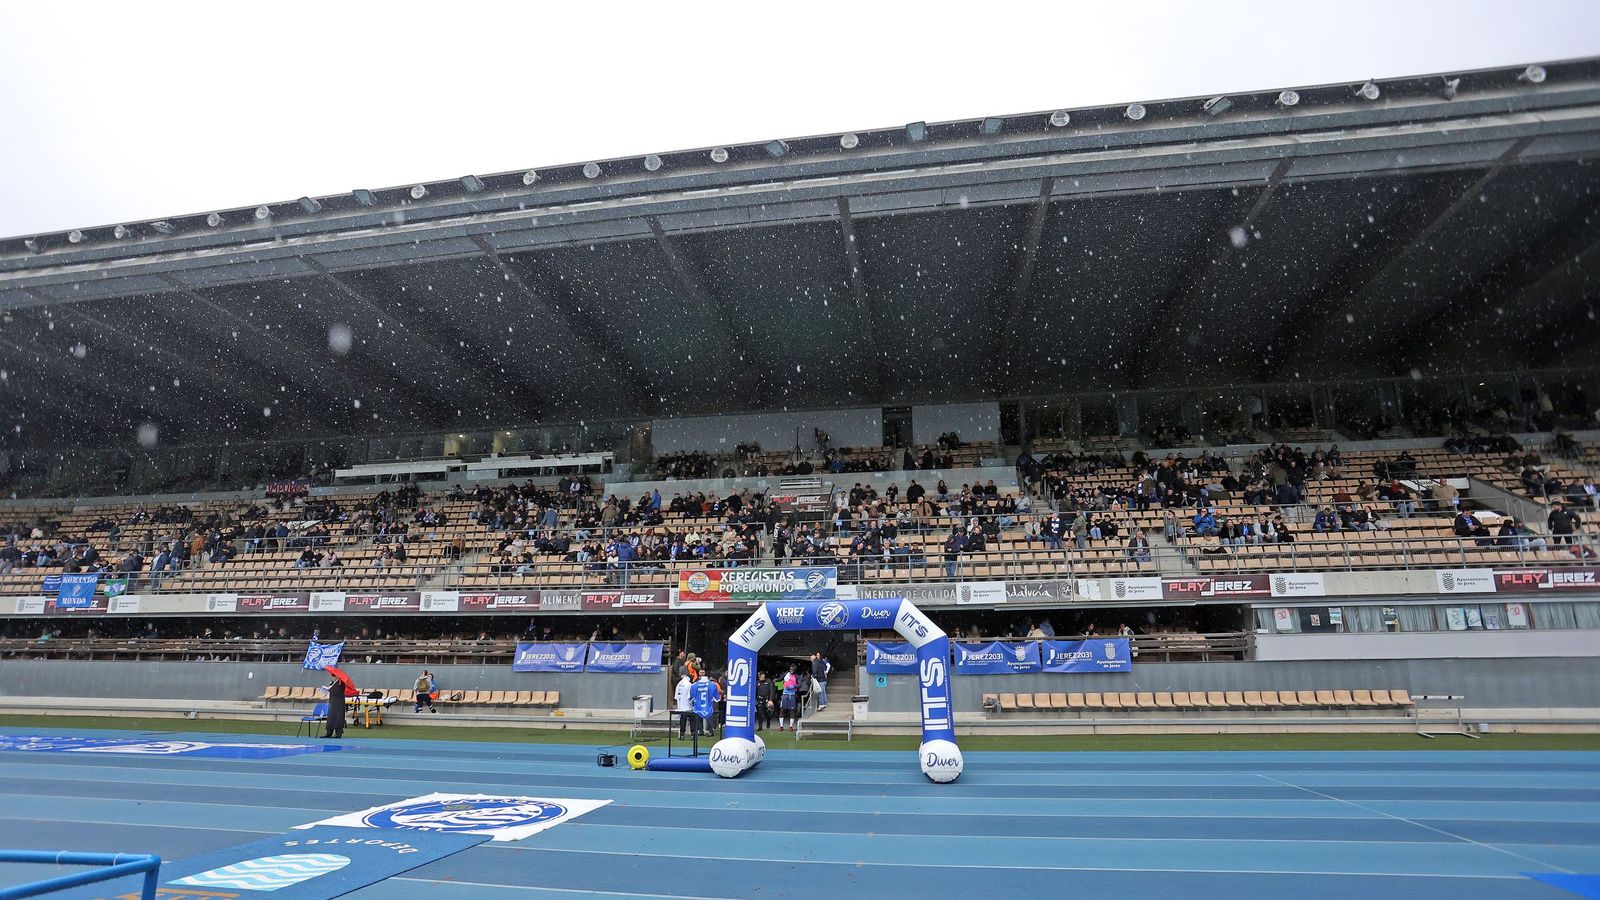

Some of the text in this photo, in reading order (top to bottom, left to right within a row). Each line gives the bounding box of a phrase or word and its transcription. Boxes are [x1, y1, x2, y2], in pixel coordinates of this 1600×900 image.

[720, 571, 794, 582] XERECISTAS
[719, 584, 738, 593] POR
[756, 583, 794, 592] MUNDO
[776, 608, 804, 616] XEREZ
[861, 606, 891, 618] Diver
[740, 617, 766, 643] ITS
[901, 612, 928, 638] ITS
[1056, 652, 1092, 660] JEREZ2031
[700, 692, 706, 707] 5
[725, 658, 748, 728] ITS
[921, 657, 948, 730] ITS
[712, 748, 742, 764] Diver
[927, 752, 959, 767] Diver
